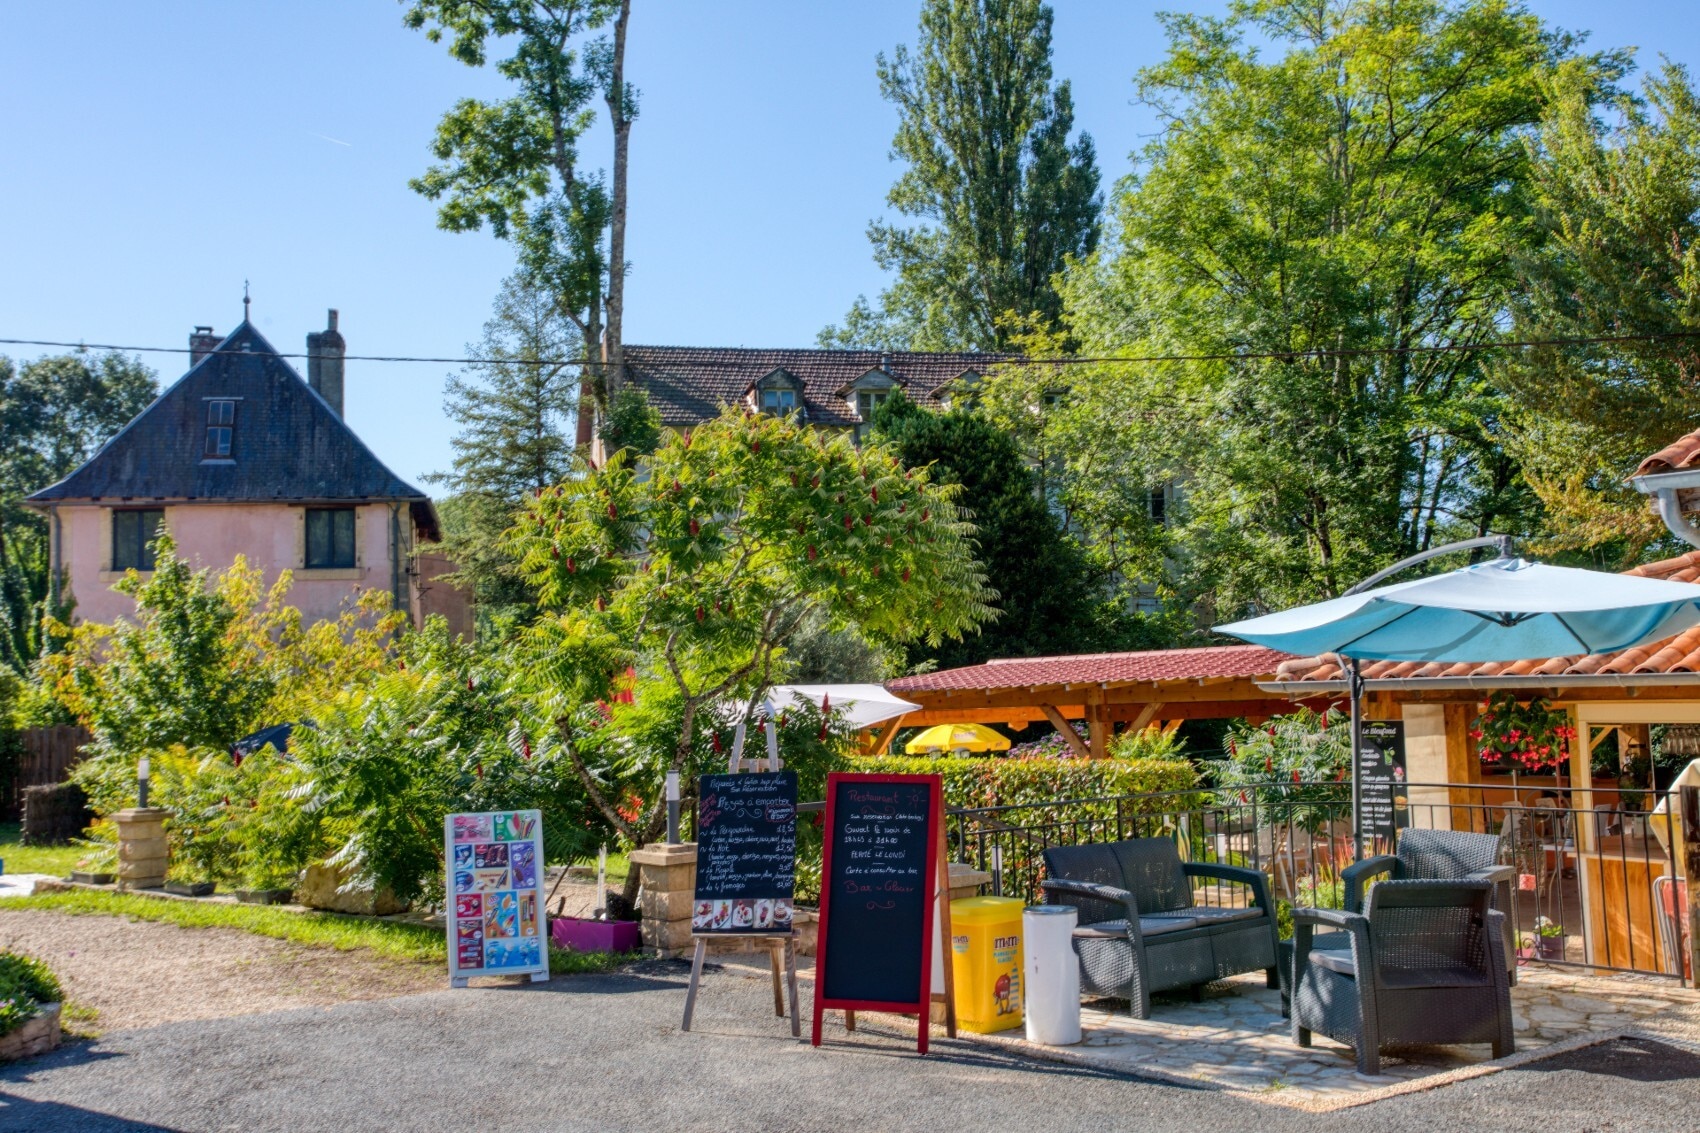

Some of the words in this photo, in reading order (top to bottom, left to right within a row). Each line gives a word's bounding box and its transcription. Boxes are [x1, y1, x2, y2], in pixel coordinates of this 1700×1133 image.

[1361, 727, 1370, 735] Le
[847, 789, 900, 804] Restaurant
[902, 826, 911, 834] de
[845, 865, 863, 875] Carte
